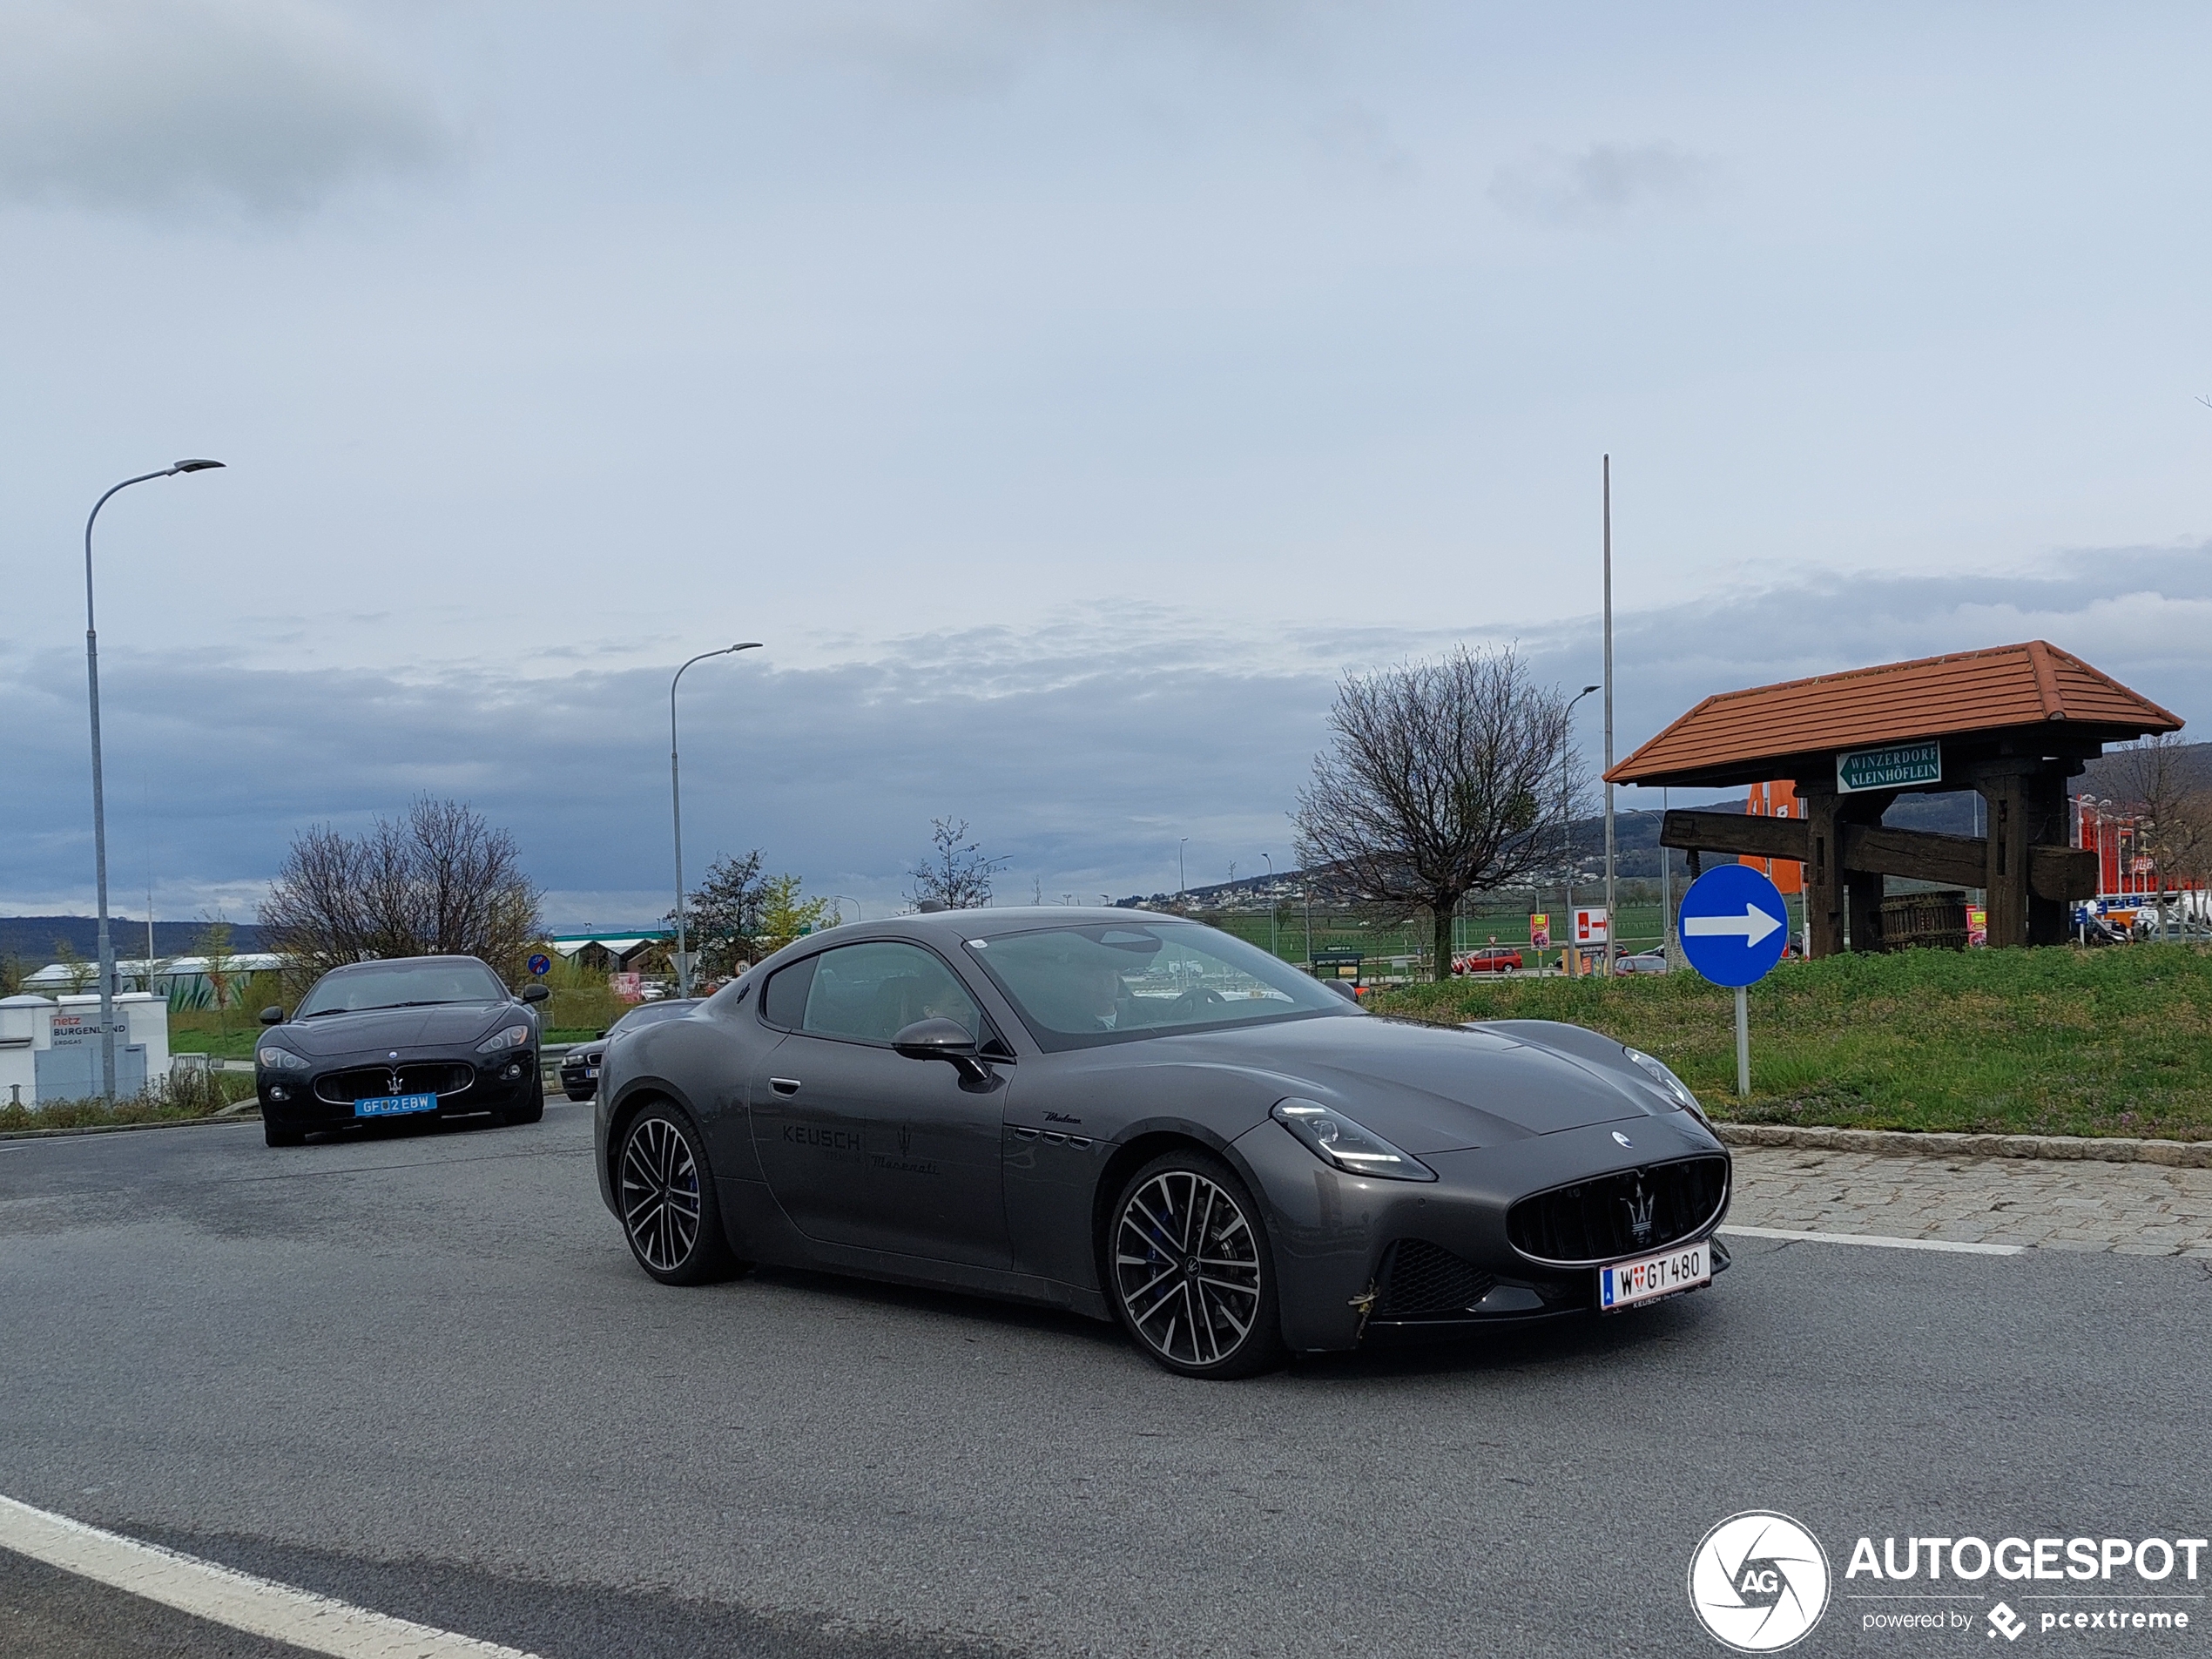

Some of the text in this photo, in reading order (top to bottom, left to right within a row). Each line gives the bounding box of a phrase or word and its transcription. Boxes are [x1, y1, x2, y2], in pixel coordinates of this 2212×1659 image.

[1851, 747, 1937, 769] WINZERDORF
[1851, 764, 1938, 786] KLEINHÖFLEIN
[53, 1017, 81, 1026] netz
[53, 1025, 126, 1036] BURGENLND
[363, 1101, 380, 1113] GF
[401, 1096, 428, 1109] EBW
[783, 1125, 860, 1151] KEUSCH
[1621, 1269, 1633, 1297] W
[1648, 1260, 1667, 1289] GT
[1671, 1251, 1700, 1282] 480
[1633, 1296, 1662, 1309] KEUSCH
